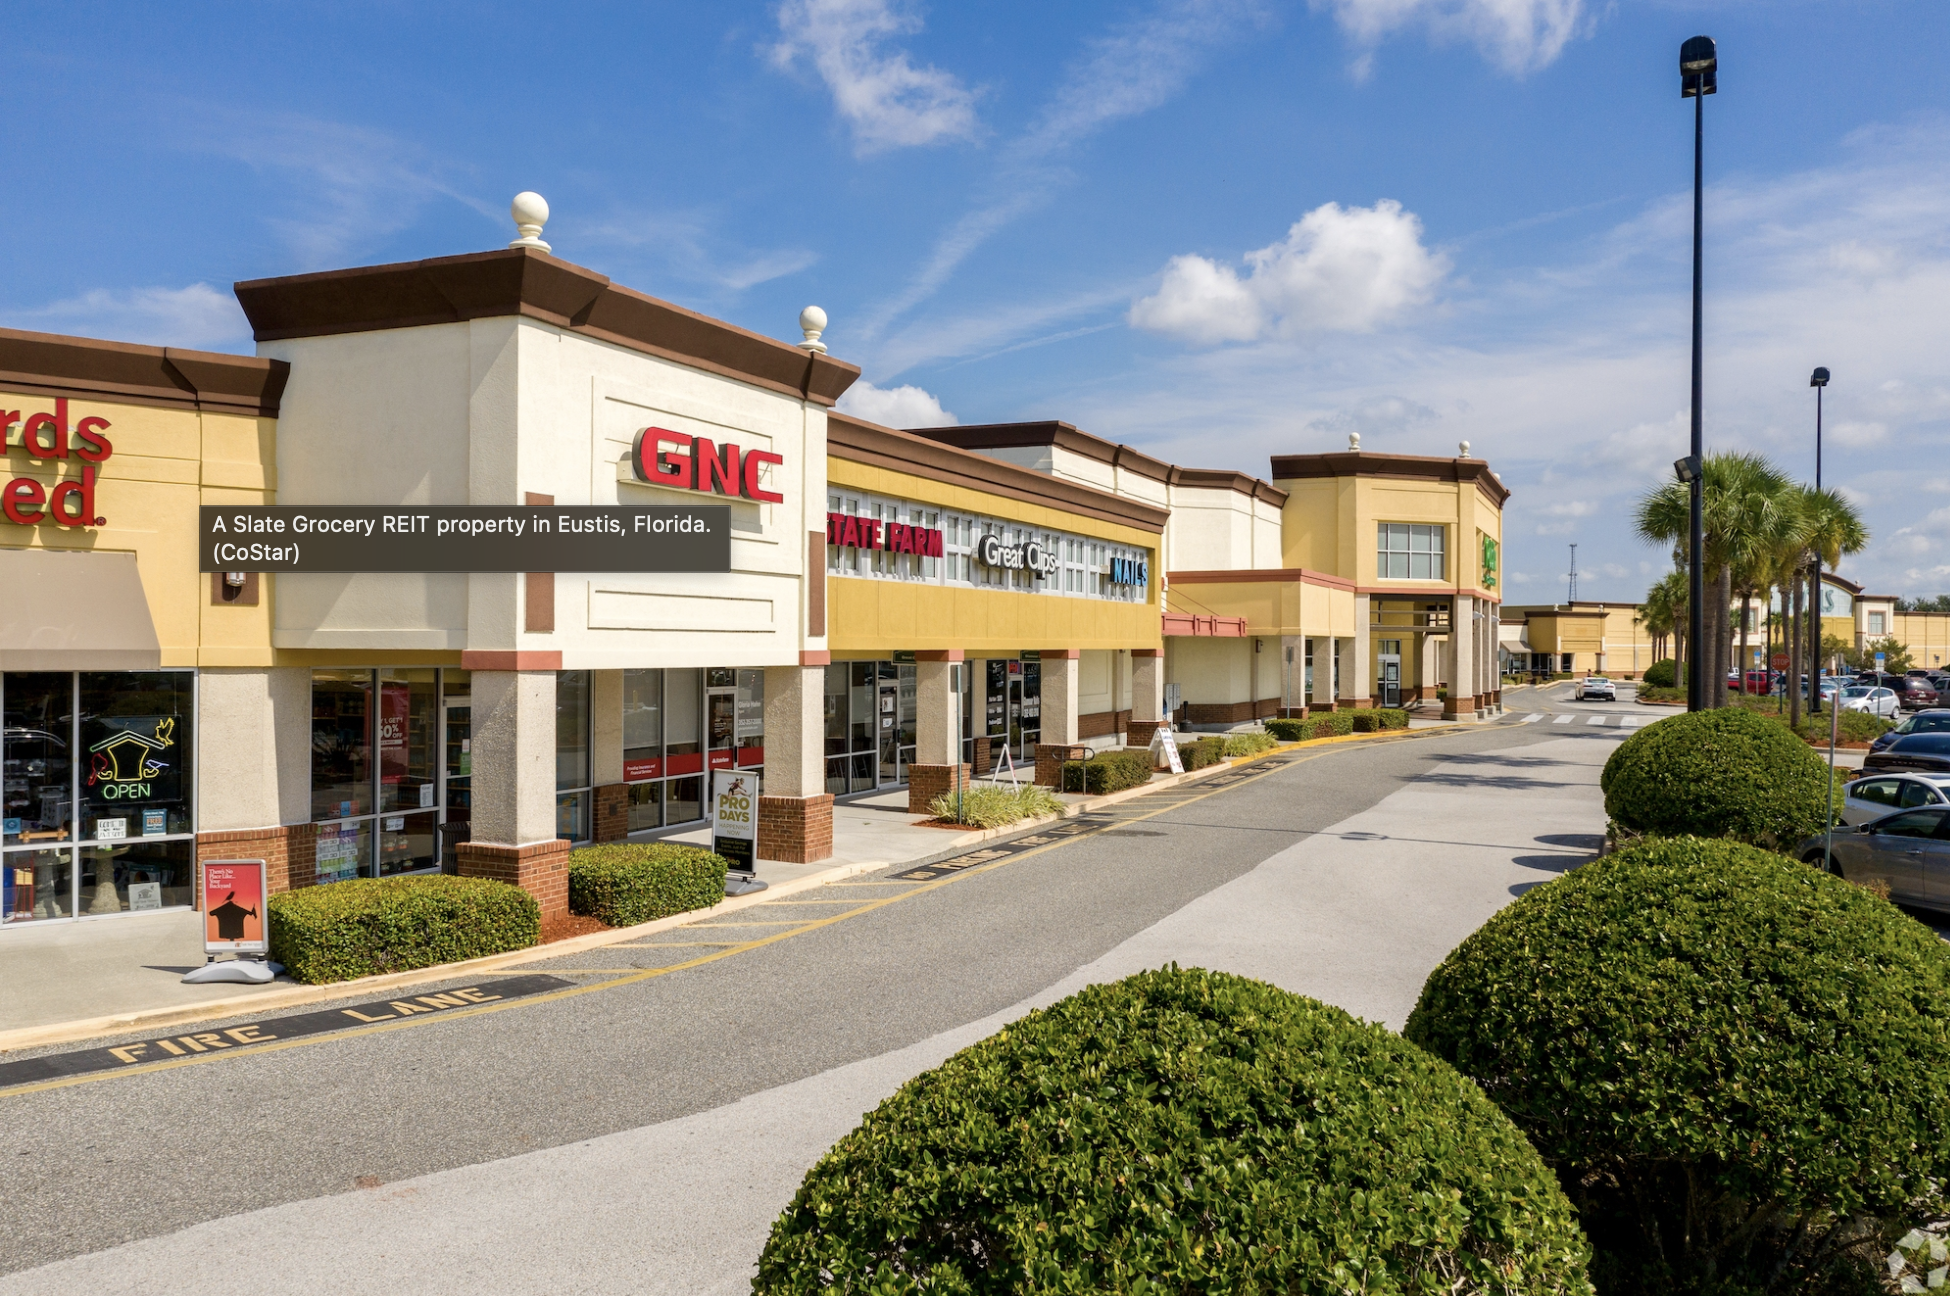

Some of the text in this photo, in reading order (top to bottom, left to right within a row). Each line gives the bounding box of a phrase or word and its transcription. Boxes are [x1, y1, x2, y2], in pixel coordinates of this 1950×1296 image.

[636, 426, 783, 504] GNC
[889, 522, 943, 558] FARM
[985, 537, 1056, 578] Great Clips
[1114, 557, 1148, 587] NAILS
[1772, 658, 1788, 666] STOP
[103, 783, 151, 799] OPEN
[719, 794, 750, 811] PRO
[719, 809, 750, 823] DAYS
[719, 823, 750, 831] HAPPENING
[107, 987, 503, 1064] FIRE LANE
